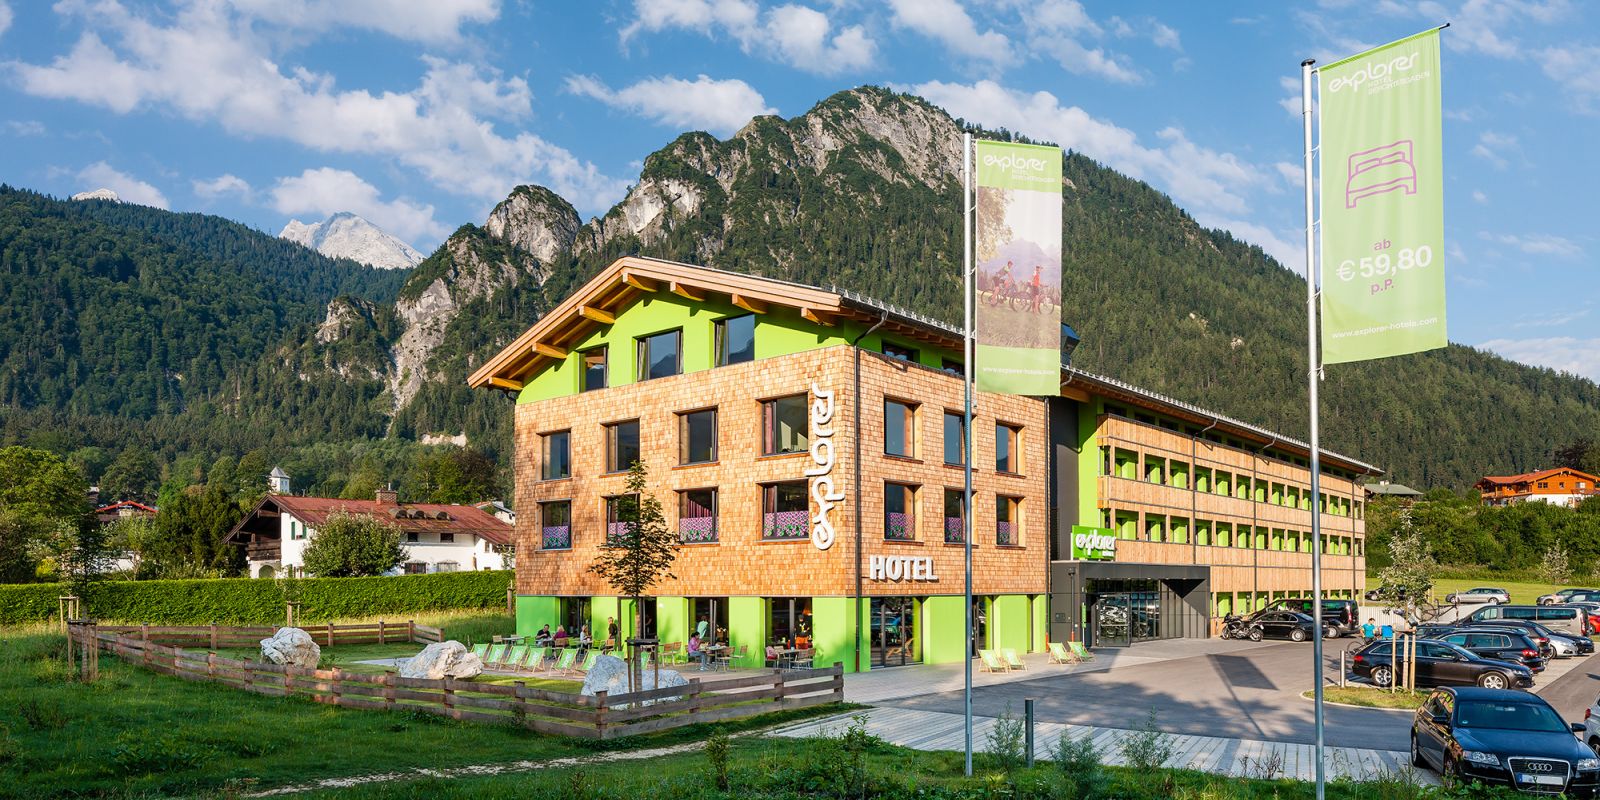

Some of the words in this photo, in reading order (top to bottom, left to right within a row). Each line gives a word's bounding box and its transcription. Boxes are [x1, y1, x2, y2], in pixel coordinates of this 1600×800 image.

[1328, 52, 1418, 92] explorer
[983, 152, 1048, 172] explorer
[1374, 239, 1391, 251] ab
[1370, 278, 1394, 295] p.P.
[804, 382, 845, 550] explorer
[869, 554, 939, 582] HOTEL
